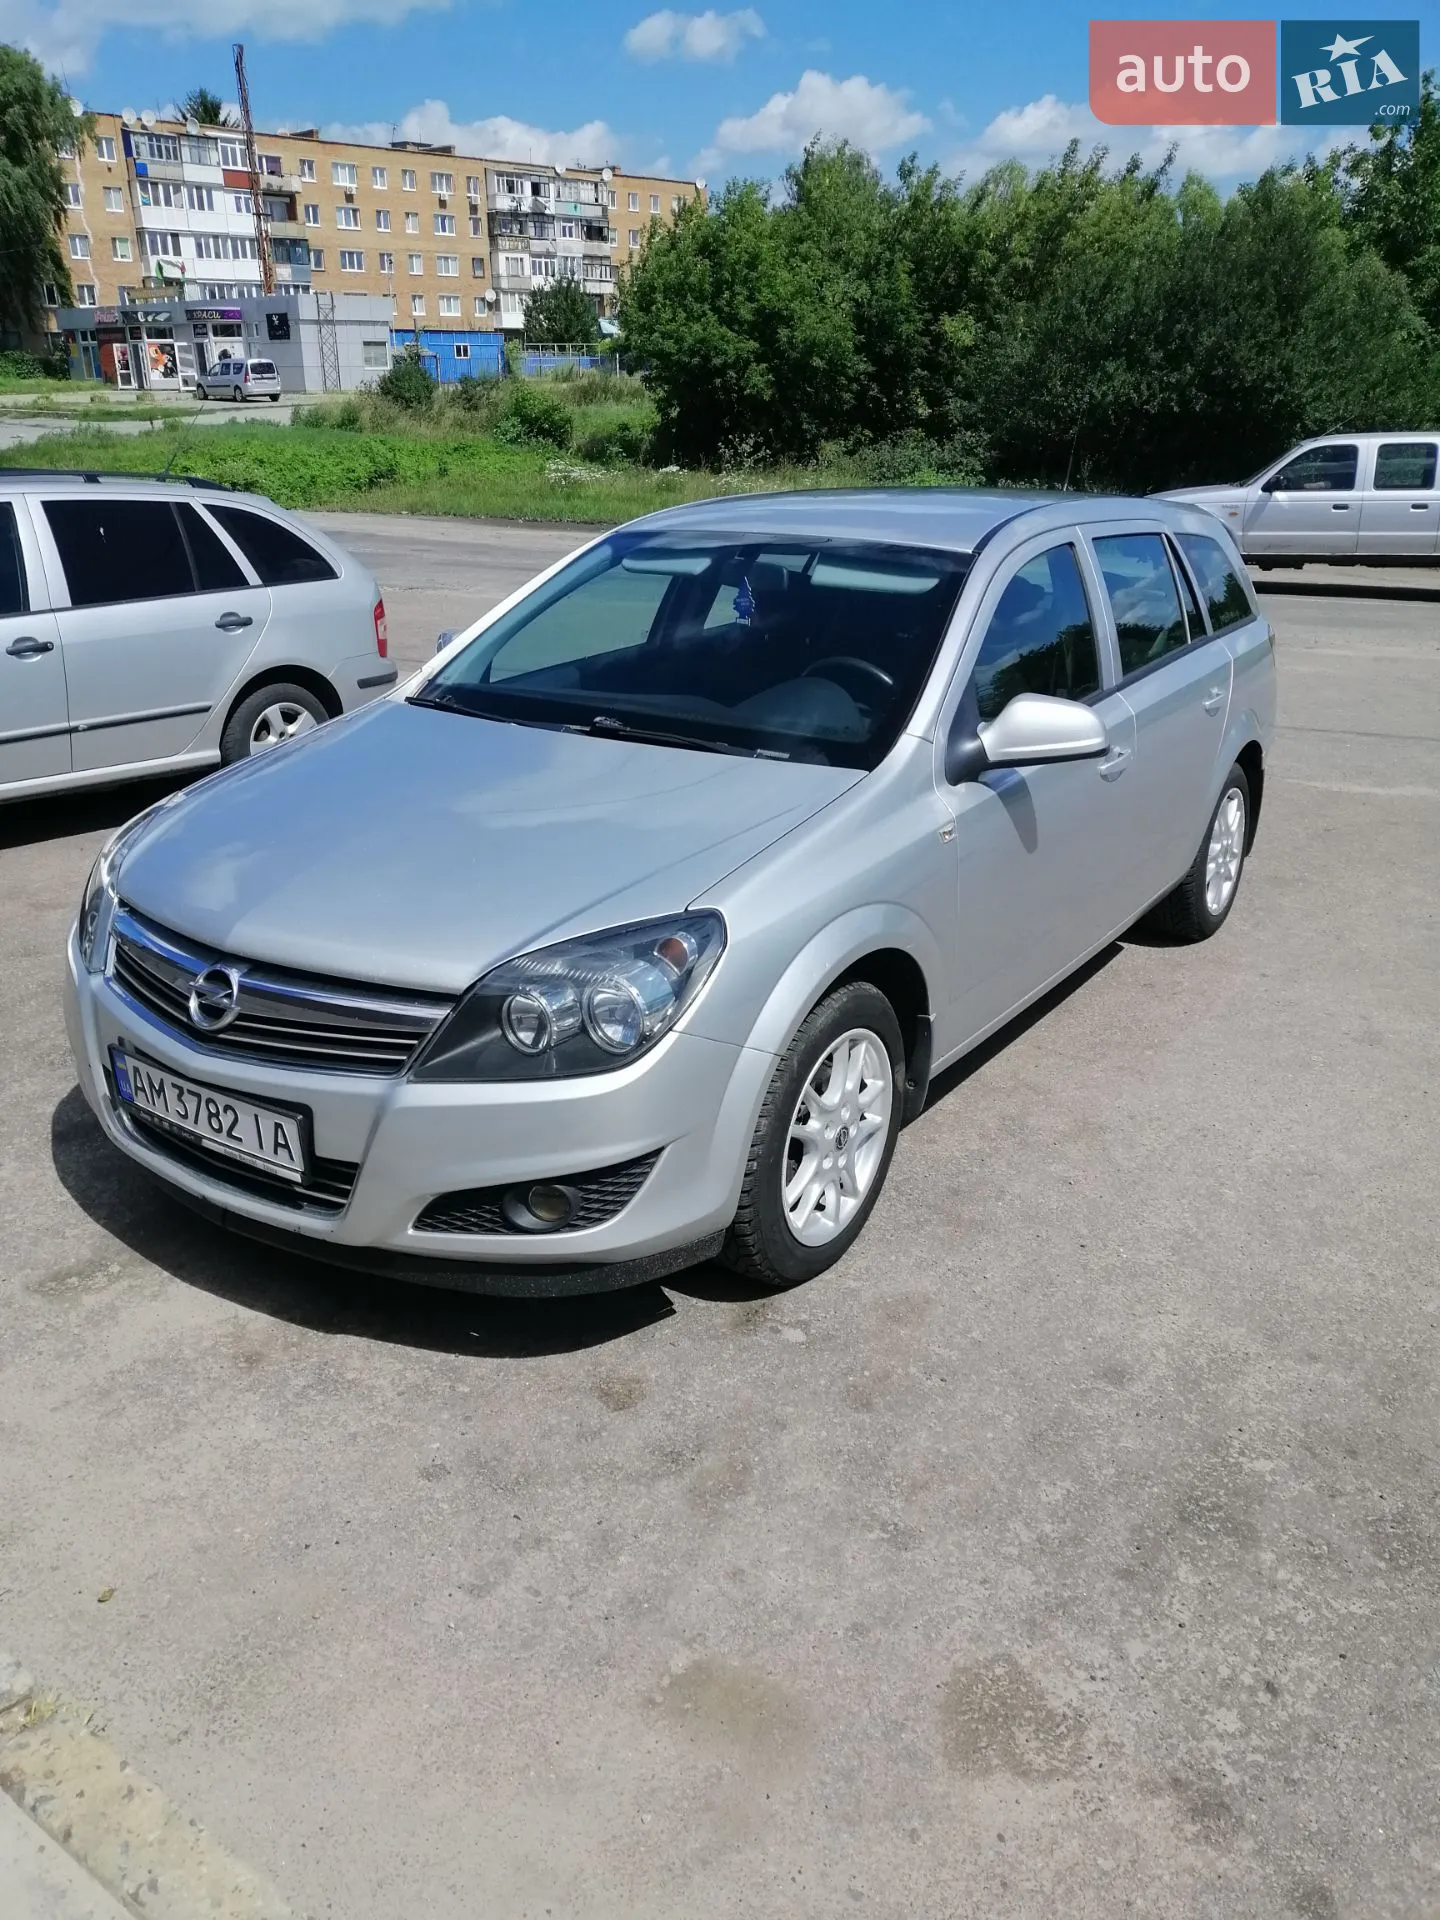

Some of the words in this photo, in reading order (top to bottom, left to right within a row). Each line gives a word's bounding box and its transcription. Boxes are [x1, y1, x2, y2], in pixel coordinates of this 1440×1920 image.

[119, 1080, 132, 1095] UA
[132, 1065, 170, 1113] AM
[171, 1081, 243, 1143] 3782
[254, 1113, 296, 1162] IA
